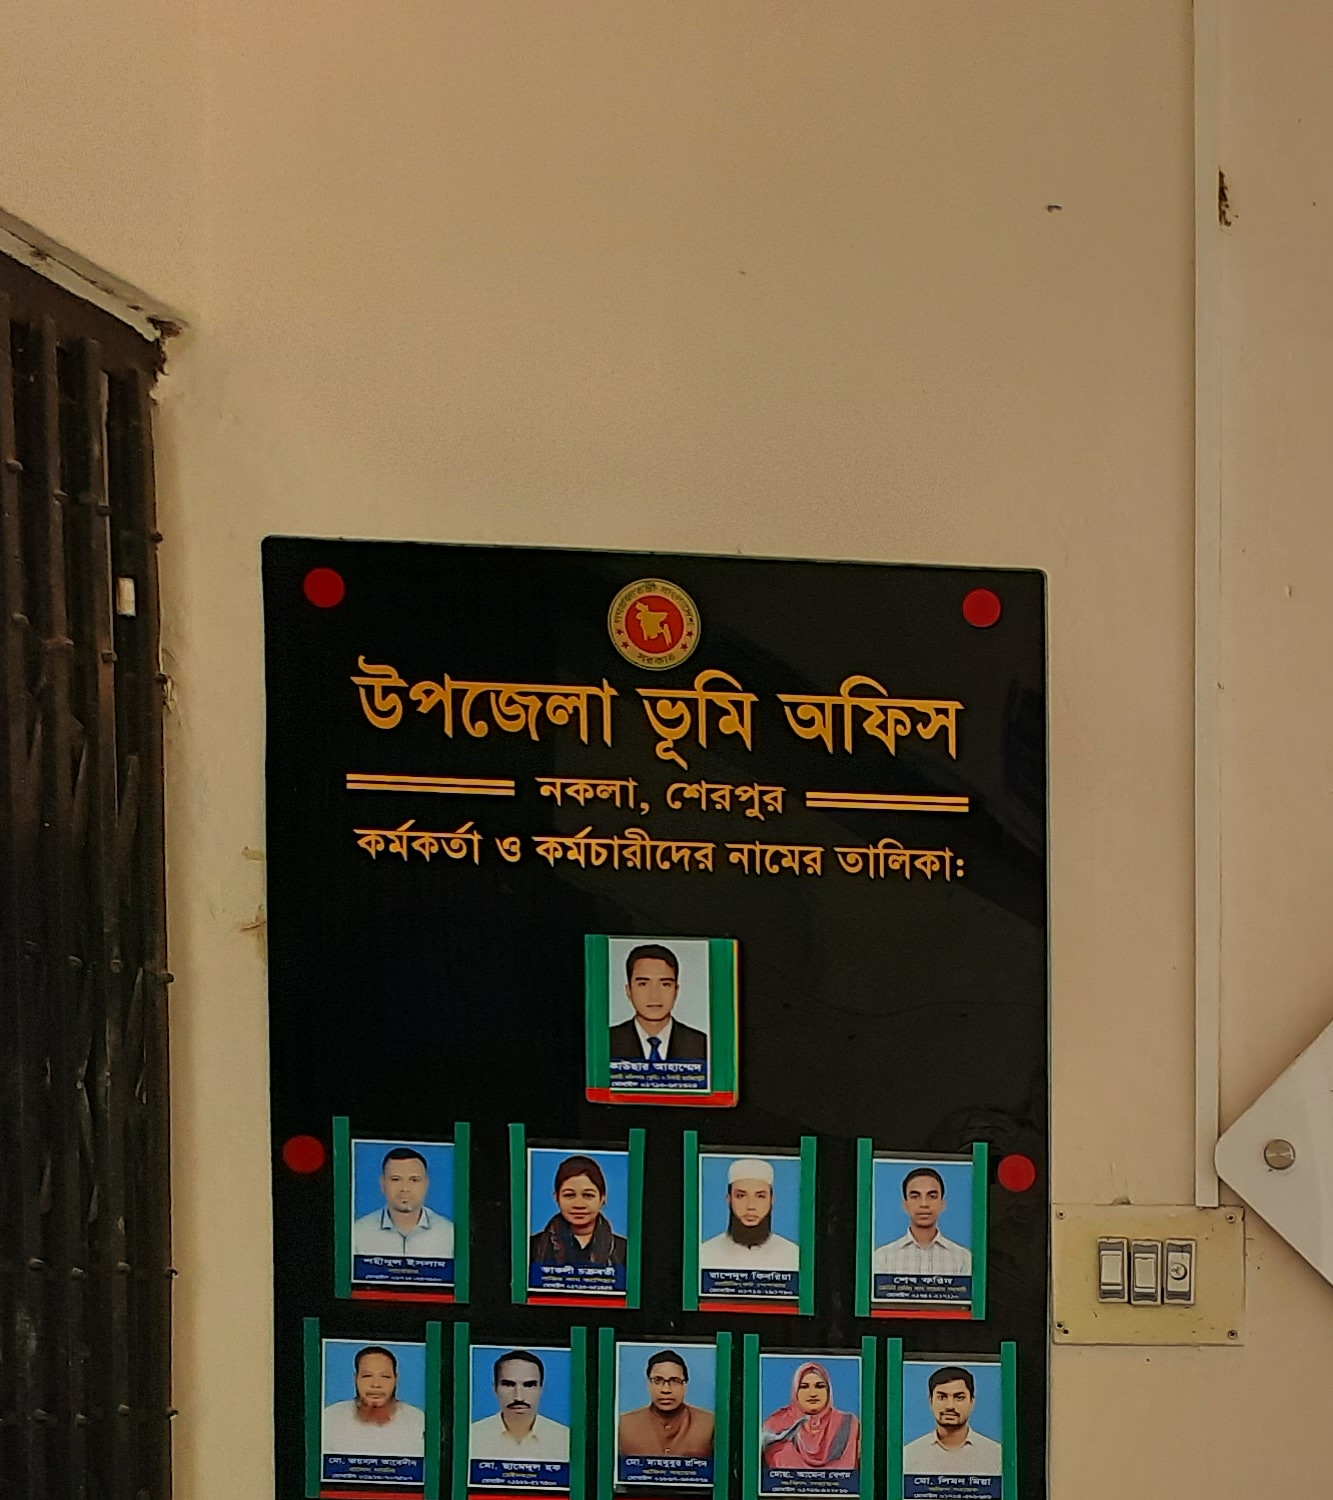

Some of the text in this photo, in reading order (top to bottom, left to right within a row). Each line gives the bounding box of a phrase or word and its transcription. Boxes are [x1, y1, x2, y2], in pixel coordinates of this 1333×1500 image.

[350, 655, 964, 770] উপজেলা ভূমি অফিস
[535, 776, 785, 820] নকলা, শেরপুর
[353, 821, 483, 865] কর্মকর্তা
[496, 839, 521, 863] ও
[532, 826, 715, 872] কর্মচারীদের
[725, 839, 824, 875] নামের
